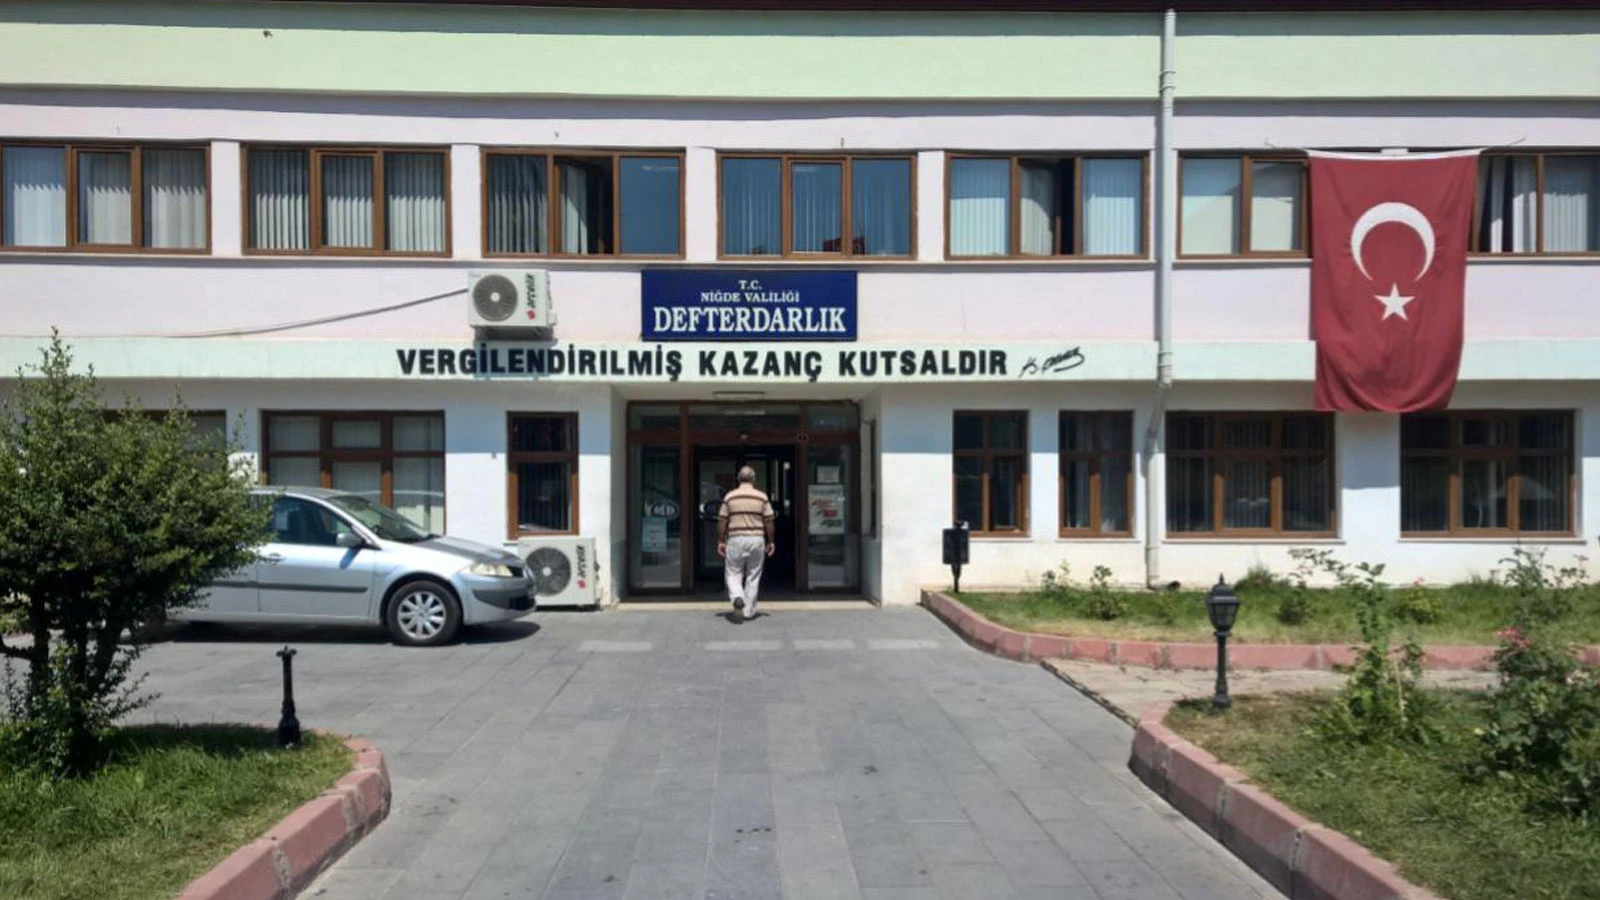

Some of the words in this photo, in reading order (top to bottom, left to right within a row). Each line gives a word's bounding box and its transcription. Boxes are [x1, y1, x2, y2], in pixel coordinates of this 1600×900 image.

[738, 279, 762, 290] T.C.
[701, 290, 740, 303] NİĞDE
[653, 306, 847, 332] DEFTERDARLIK
[700, 350, 823, 382] KAZANÇ
[838, 350, 1008, 376] KUTSALDIR
